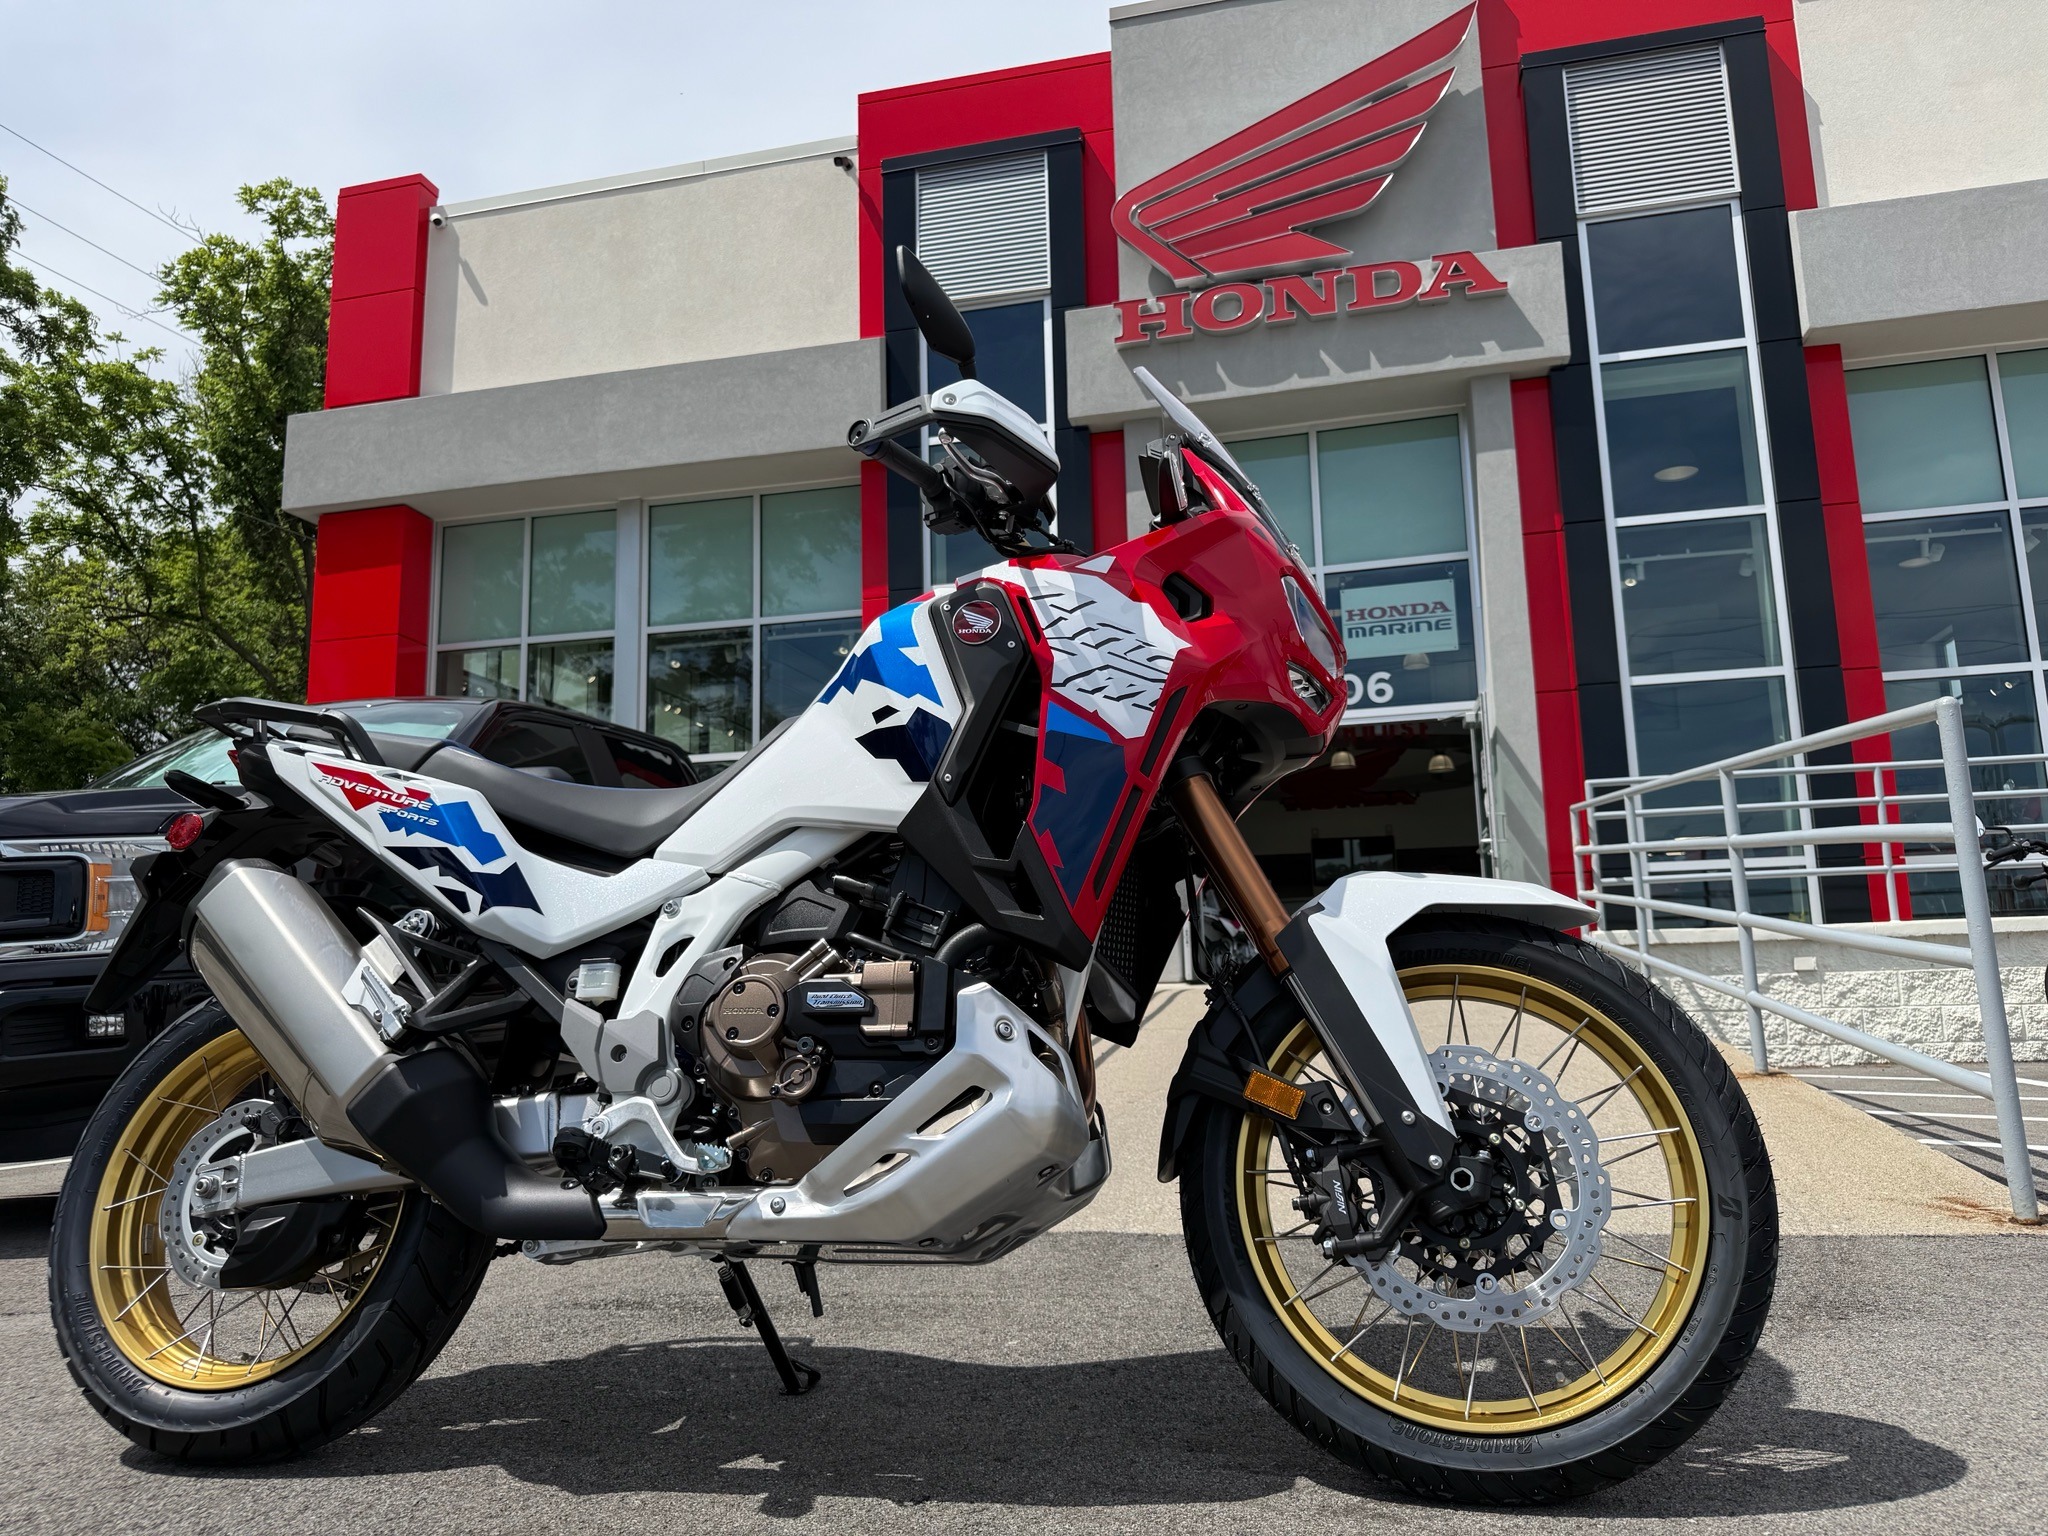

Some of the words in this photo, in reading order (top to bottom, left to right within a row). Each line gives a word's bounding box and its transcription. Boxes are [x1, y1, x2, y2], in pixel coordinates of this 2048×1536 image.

[1113, 251, 1508, 347] HONDA
[1345, 601, 1451, 622] HONDA
[1347, 618, 1452, 639] MARINE
[318, 774, 434, 811] ADVENTURE
[377, 805, 440, 826] SPORTS
[722, 1006, 764, 1016] HONDA
[74, 1291, 151, 1397] BRIDGESTONE
[1391, 1421, 1534, 1455] BRIDGESTONE
